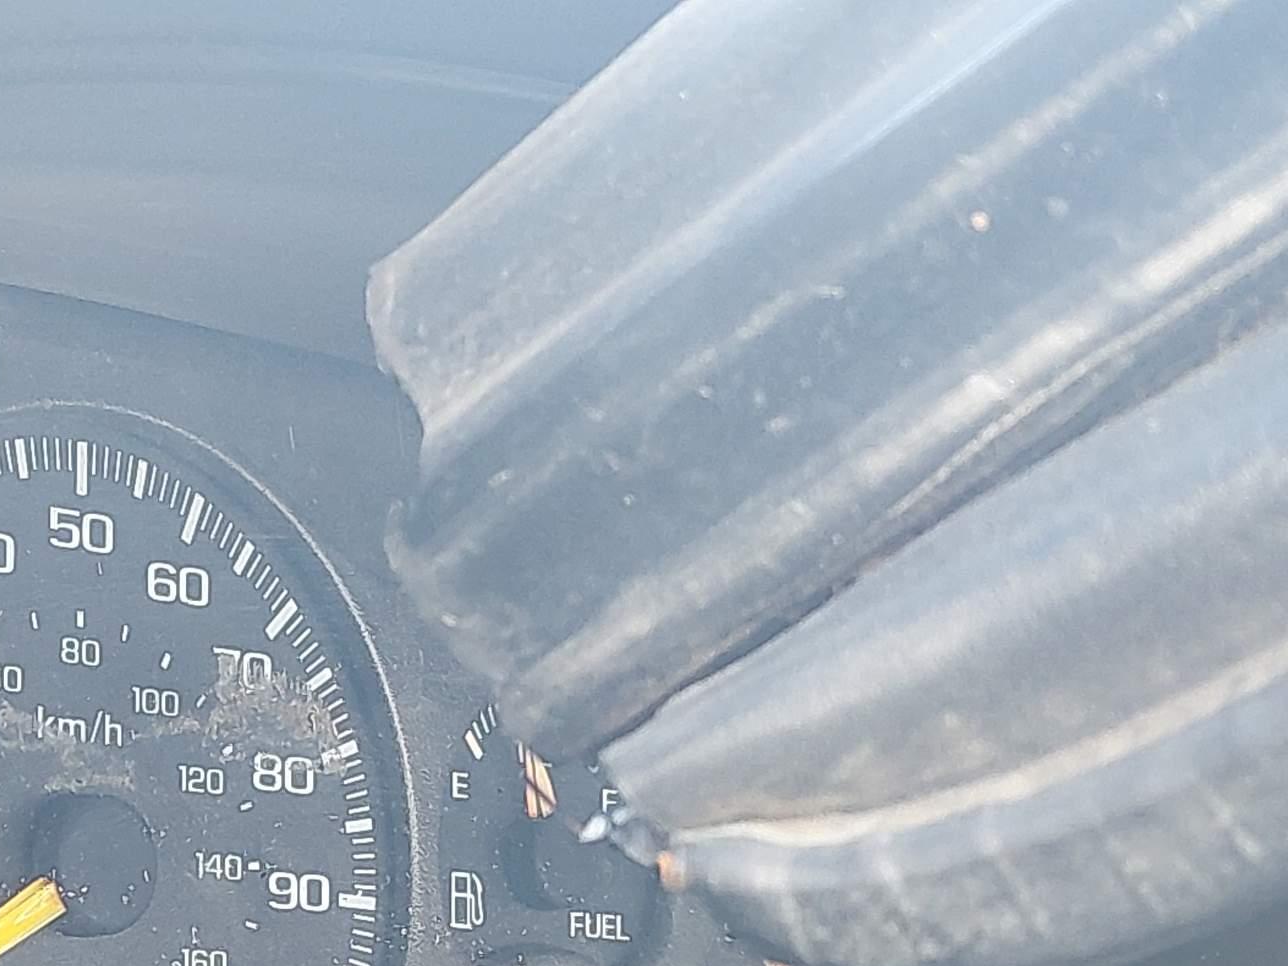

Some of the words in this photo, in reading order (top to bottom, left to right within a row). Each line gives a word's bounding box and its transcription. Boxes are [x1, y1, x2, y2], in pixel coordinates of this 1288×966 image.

[49, 506, 114, 554] 50
[146, 563, 209, 606] 60
[61, 637, 101, 667] 80
[213, 647, 272, 690] 70
[132, 687, 179, 717] 100
[36, 705, 123, 747] km/h
[179, 764, 224, 795] 120
[252, 753, 314, 795] 80
[452, 772, 469, 799] E
[602, 788, 619, 813] F
[196, 852, 242, 881] 140
[269, 872, 330, 912] 90
[569, 912, 631, 941] FUEL
